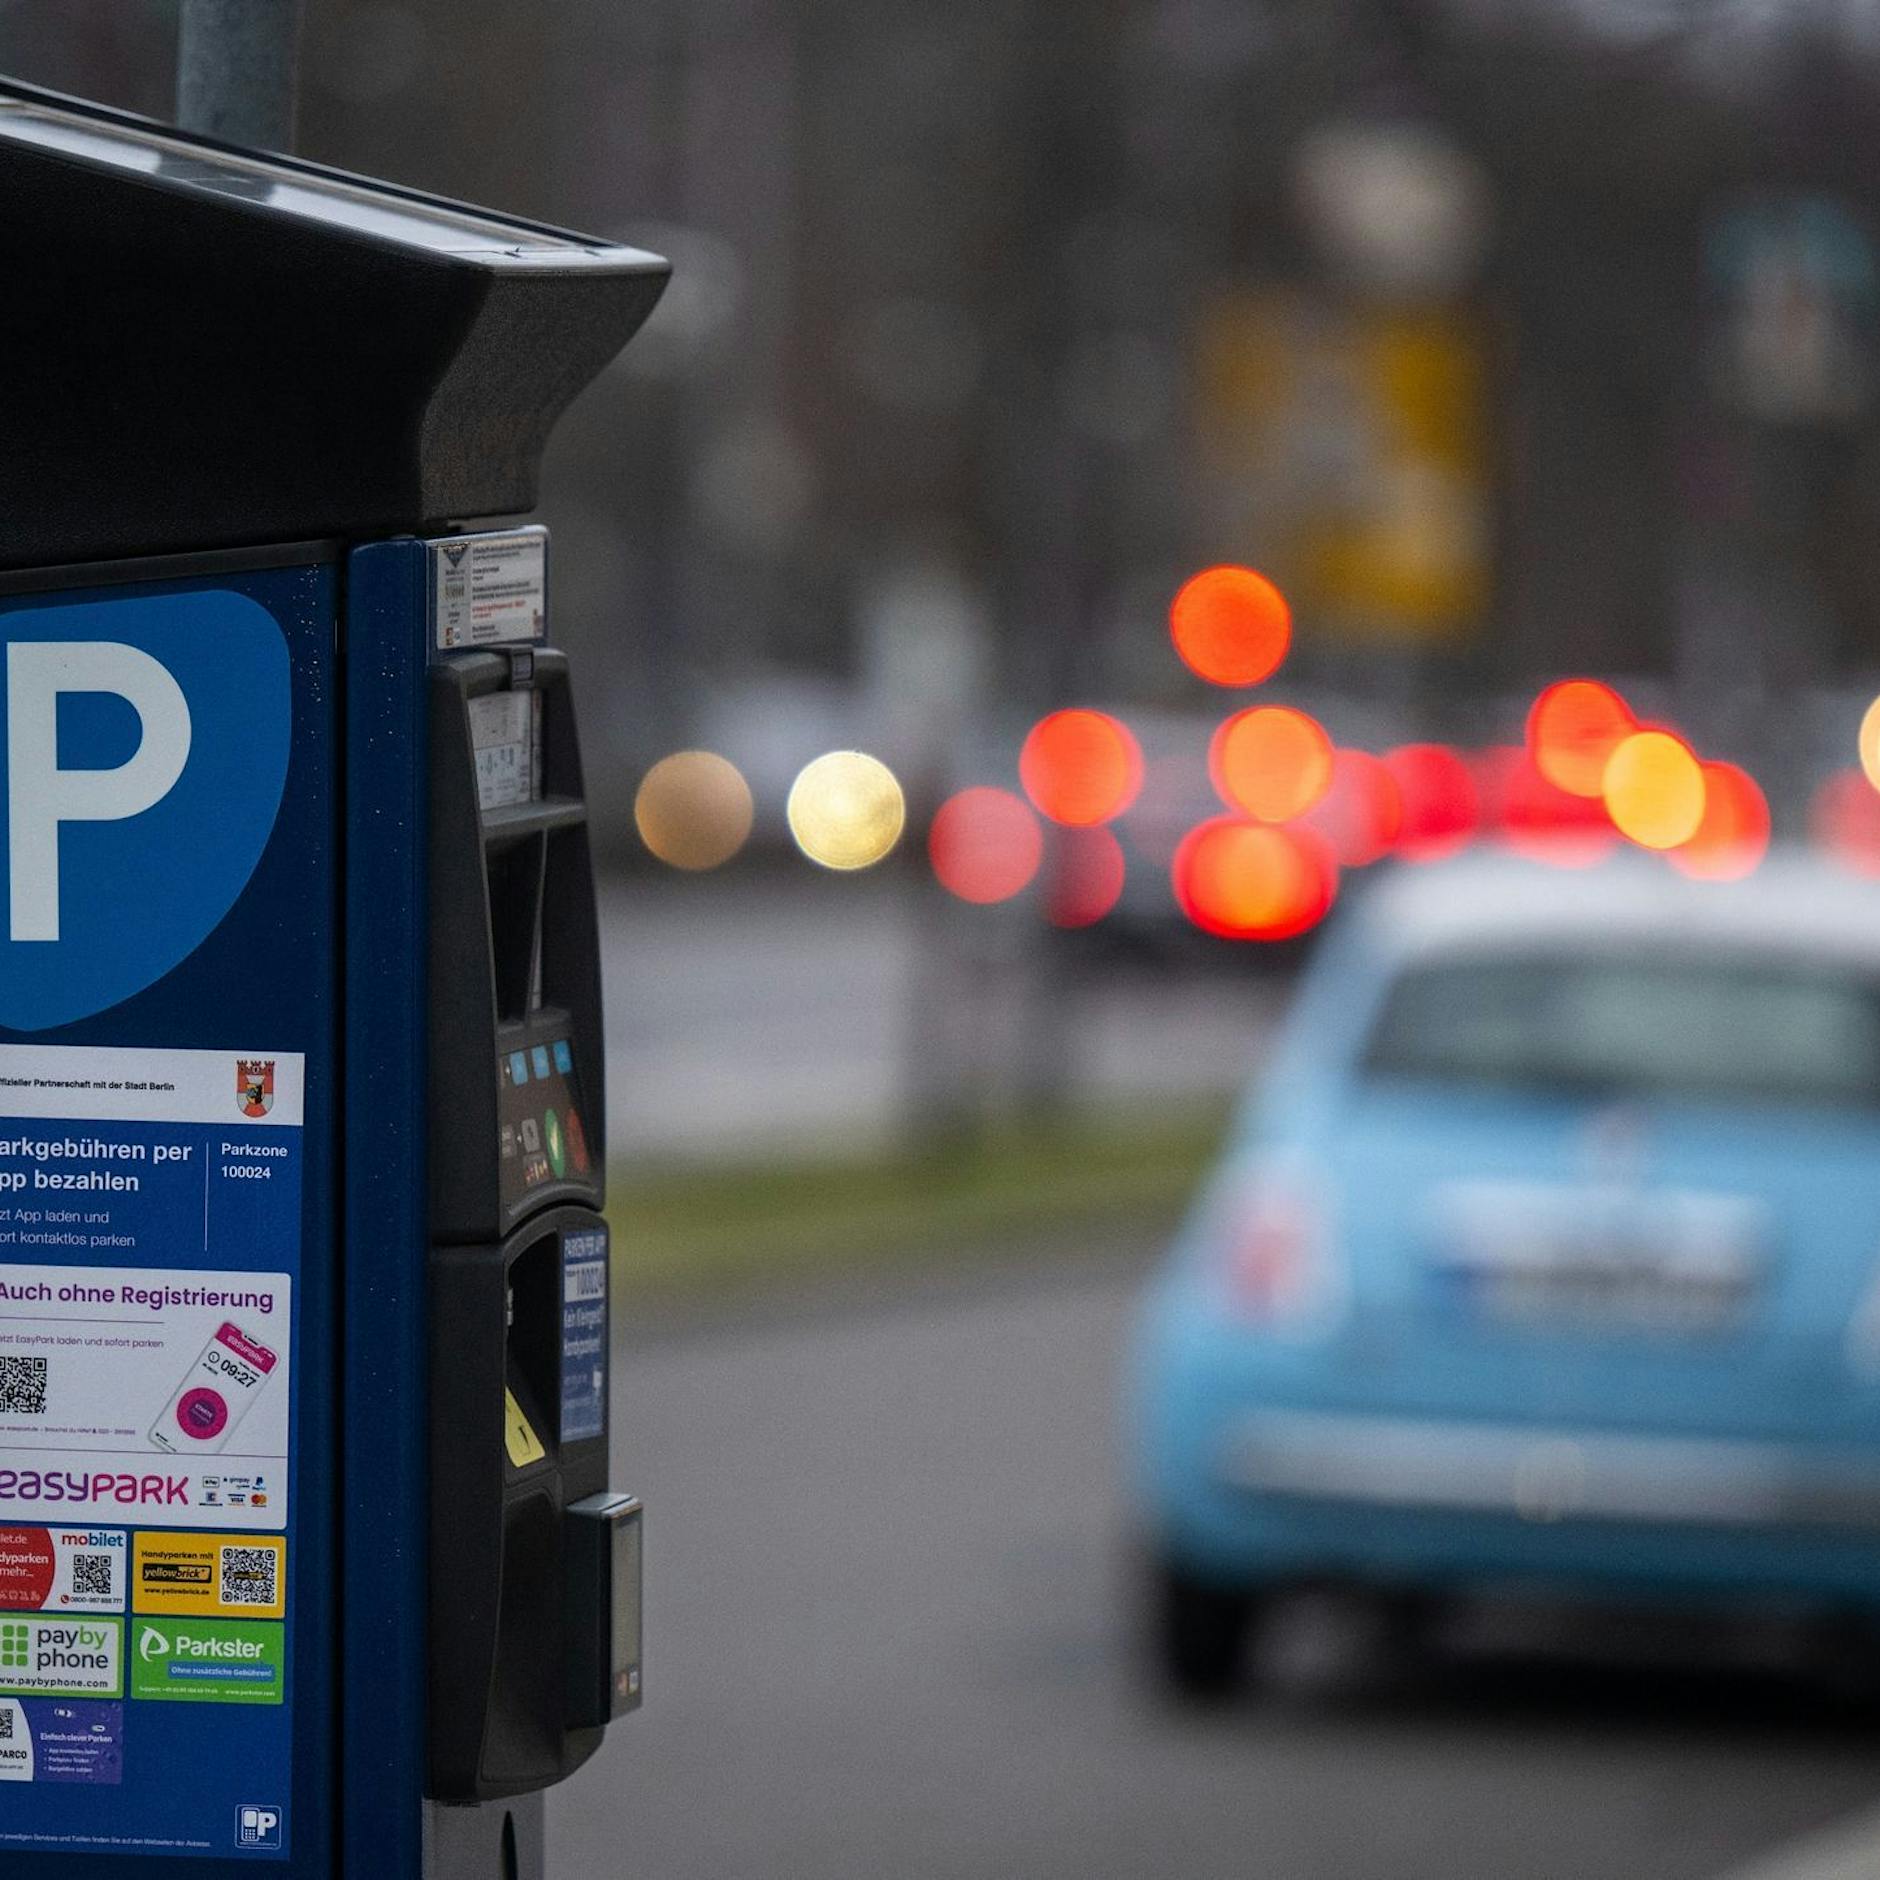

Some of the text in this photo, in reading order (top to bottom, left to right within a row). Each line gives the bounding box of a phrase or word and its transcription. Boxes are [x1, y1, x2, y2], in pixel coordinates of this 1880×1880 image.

[7, 641, 192, 941] P
[34, 1079, 91, 1089] Partnerschaft
[93, 1081, 106, 1089] mit
[109, 1082, 122, 1090] der
[125, 1081, 147, 1091] Stadt
[149, 1083, 175, 1091] Berlin
[0, 1137, 192, 1164] arkgebühren per
[221, 1143, 288, 1157] Parkzone
[0, 1169, 139, 1192] pp bezahlen
[221, 1166, 271, 1179] 100024
[15, 1208, 42, 1224] App
[45, 1210, 80, 1222] laden
[84, 1211, 109, 1223] und
[20, 1231, 87, 1246] kontaktlos
[90, 1235, 135, 1248] parken
[0, 1282, 274, 1314] Auch ohne Registrierung
[15, 1335, 55, 1347] EasyPark
[56, 1337, 83, 1346] laden
[84, 1338, 102, 1347] und
[104, 1338, 130, 1347] sofort
[132, 1340, 164, 1349] parken
[219, 1359, 257, 1388] 09:27
[62, 1532, 124, 1547] mobilet
[141, 1550, 214, 1560] Handyparken mit
[144, 1566, 200, 1580] yellowbrick
[37, 1625, 108, 1649] payby
[175, 1635, 265, 1659] Parkster
[37, 1648, 109, 1671] phone
[192, 1667, 232, 1676] zusätzliche
